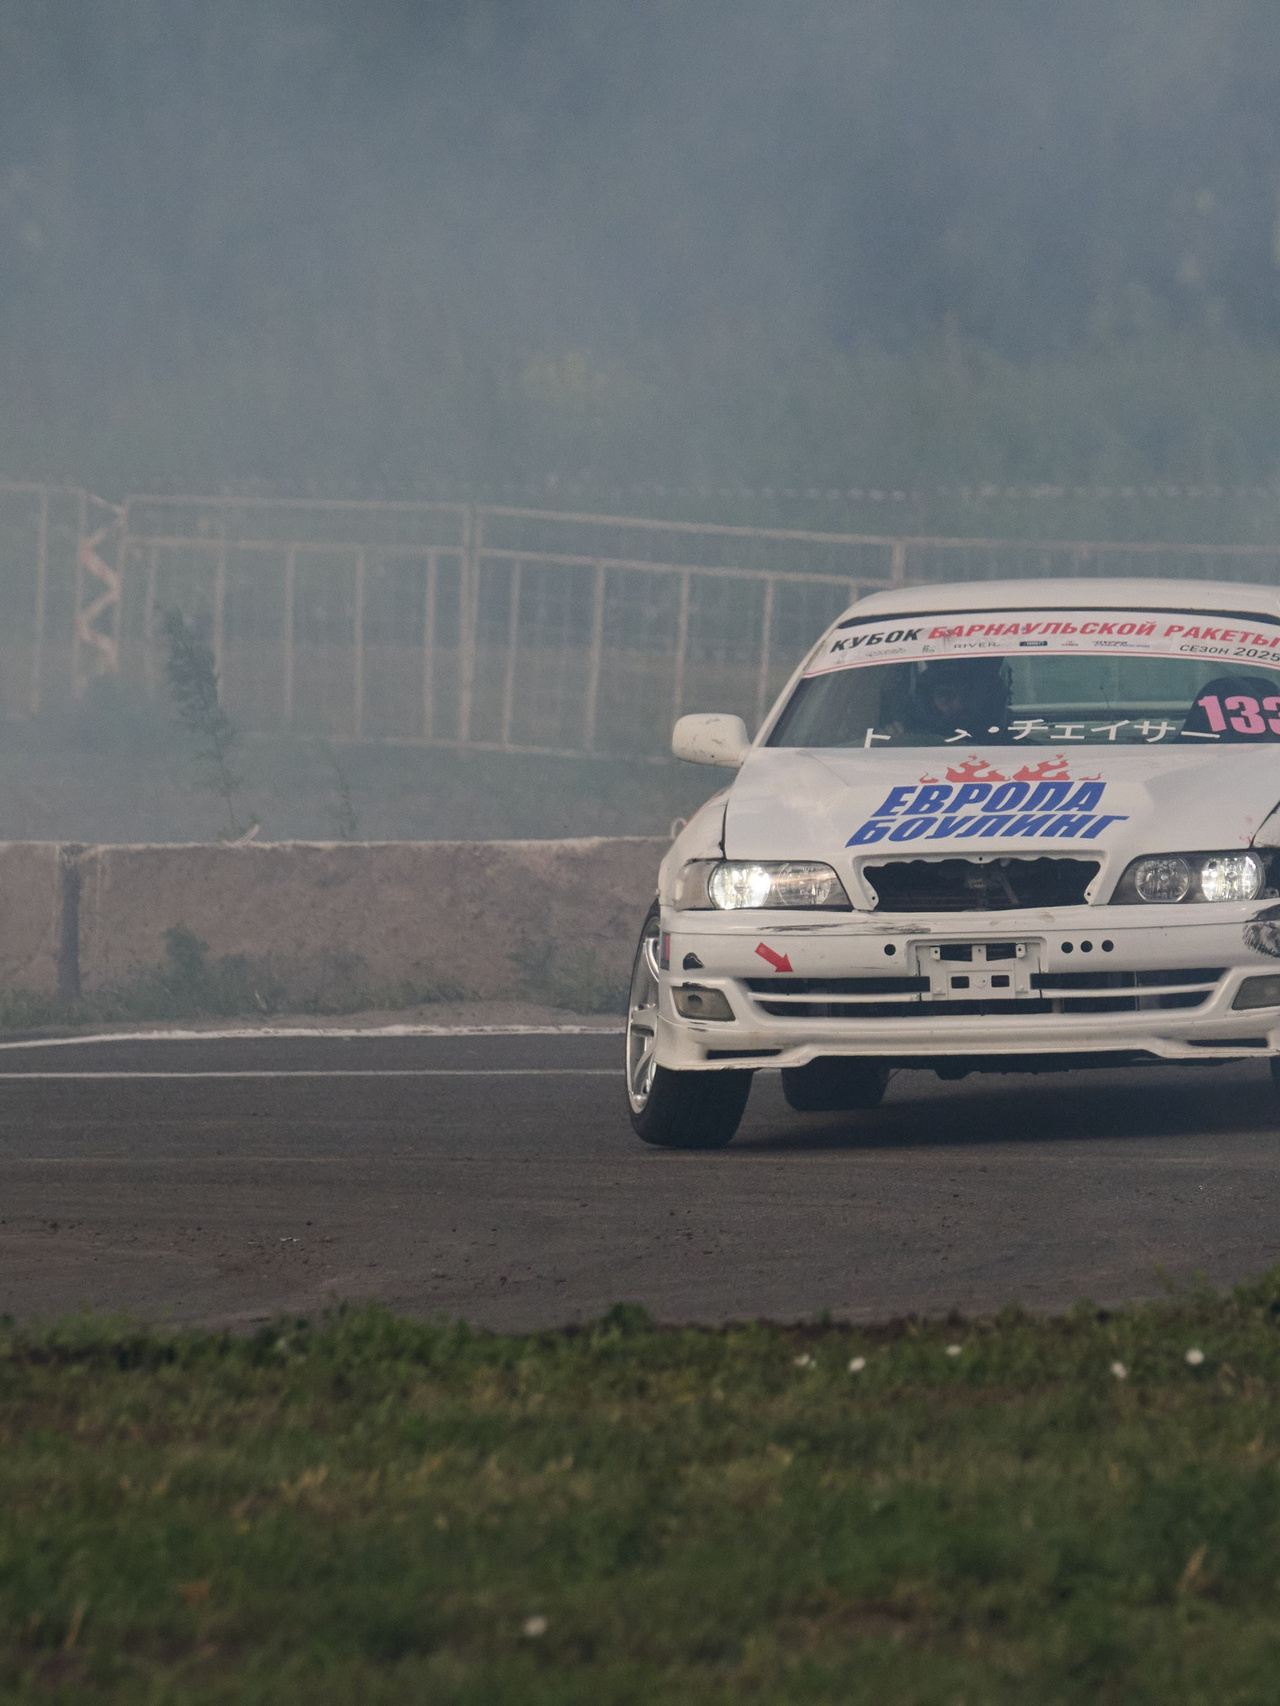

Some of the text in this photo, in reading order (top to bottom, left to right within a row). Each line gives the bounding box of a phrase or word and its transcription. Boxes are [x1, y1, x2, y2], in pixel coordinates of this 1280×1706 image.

[830, 627, 925, 653] КУБОК
[927, 621, 1157, 640] БАРНАУЛЬСКОЙ
[1179, 644, 1229, 655] СЕЗОН
[870, 781, 1107, 818] ЕВРОПА
[844, 814, 1131, 849] БОУЛИНГ
